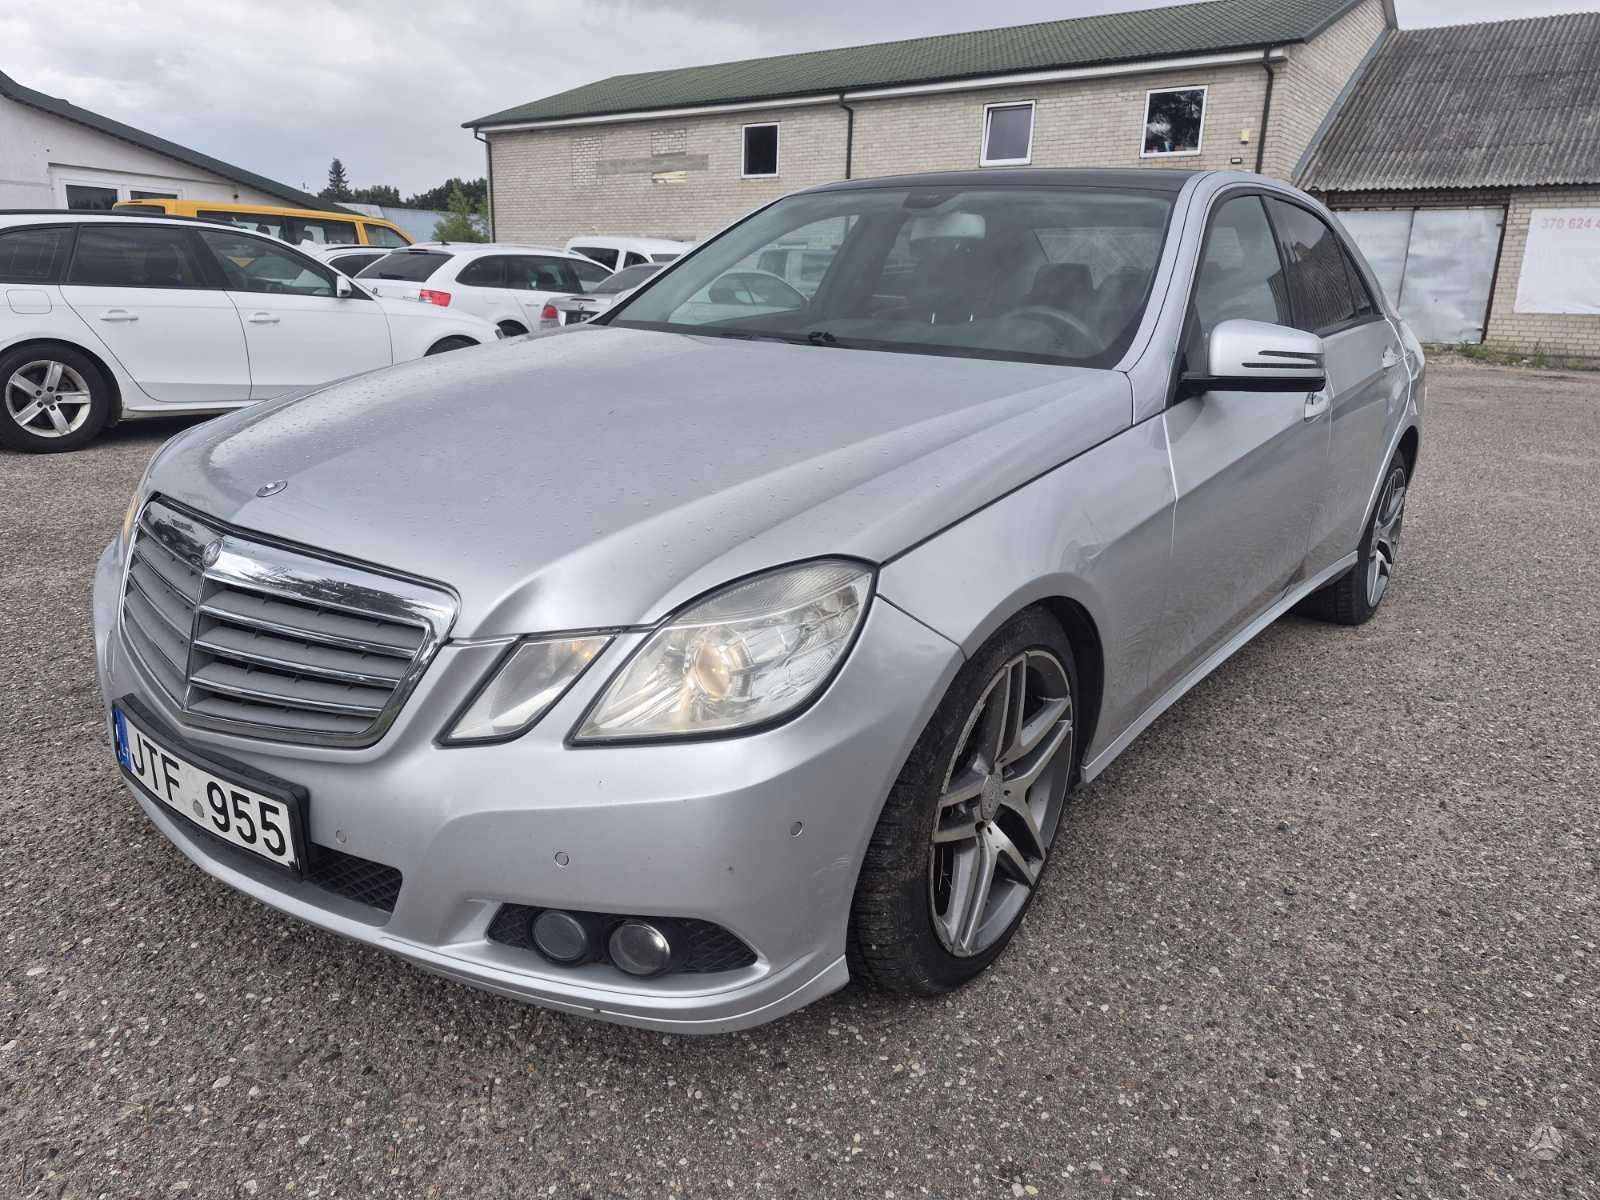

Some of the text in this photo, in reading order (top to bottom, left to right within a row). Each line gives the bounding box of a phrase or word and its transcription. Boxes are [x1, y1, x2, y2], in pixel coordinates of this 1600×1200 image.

[1541, 217, 1565, 229] 370
[1568, 217, 1591, 230] 624
[132, 733, 286, 857] JTF 955
